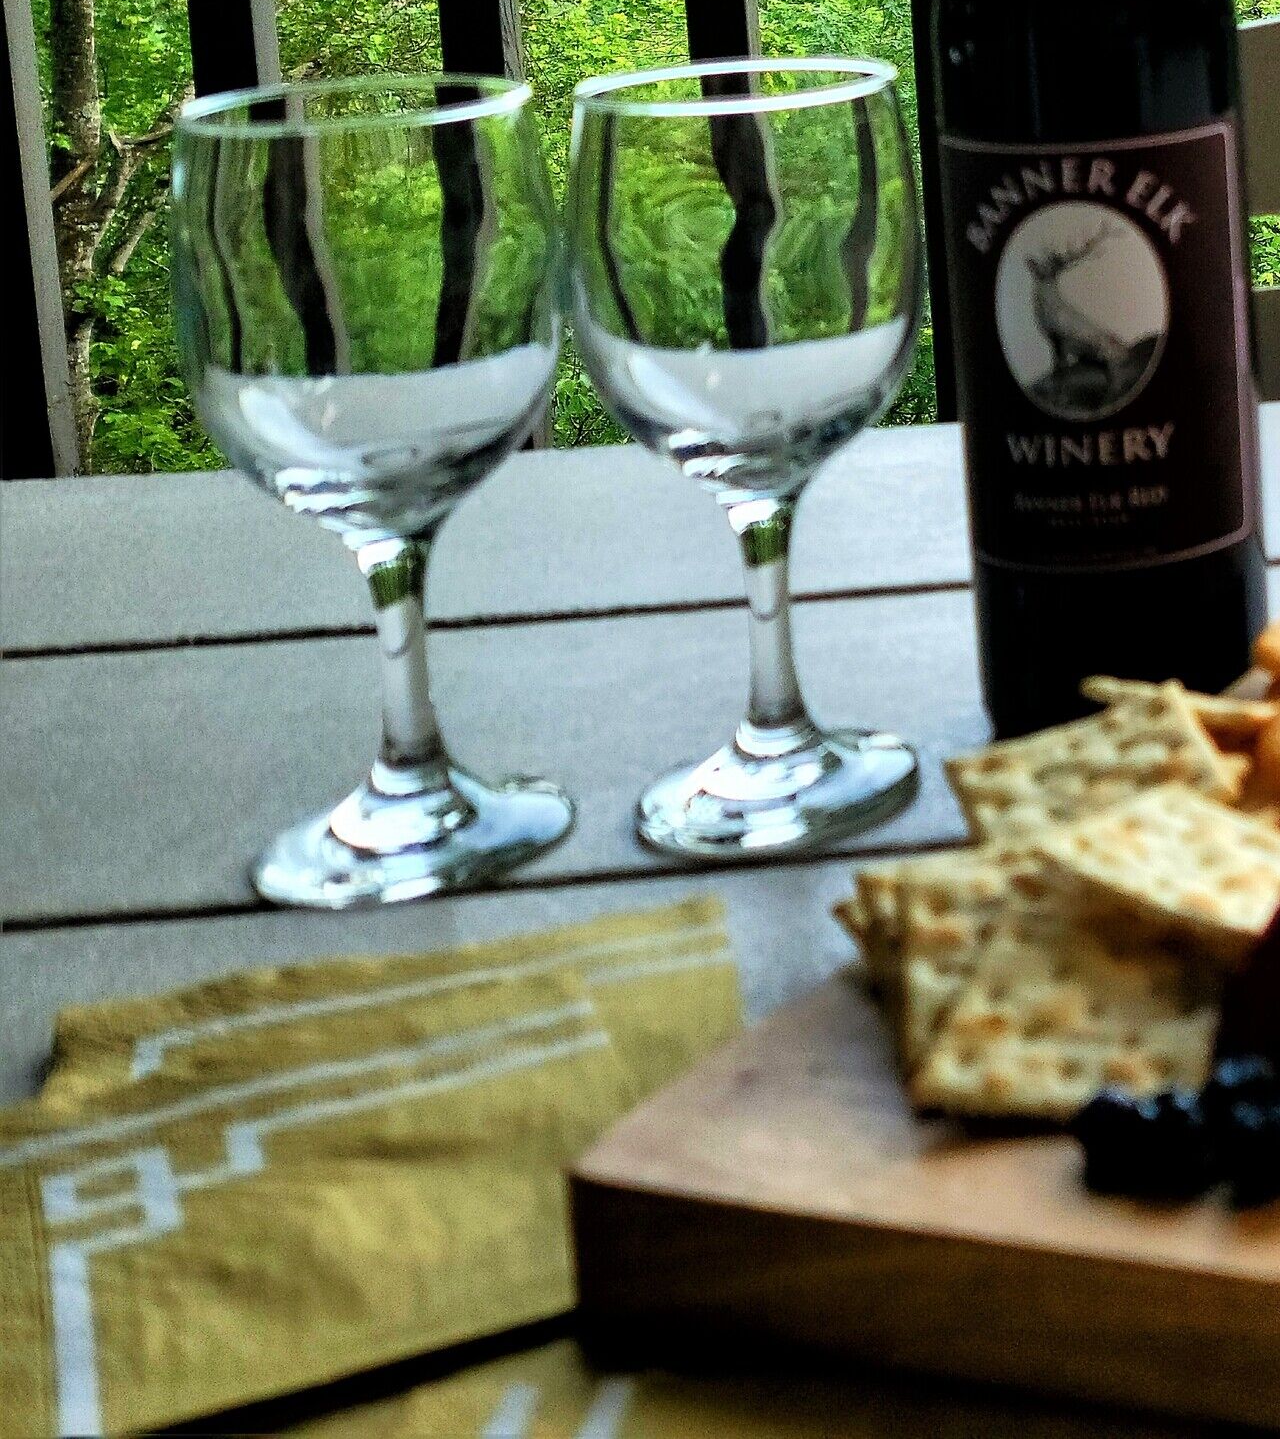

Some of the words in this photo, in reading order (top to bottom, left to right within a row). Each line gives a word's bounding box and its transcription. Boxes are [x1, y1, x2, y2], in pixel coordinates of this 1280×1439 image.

[966, 157, 1116, 253] BANNER
[1126, 170, 1196, 244] ELK
[1007, 422, 1175, 467] WINERY
